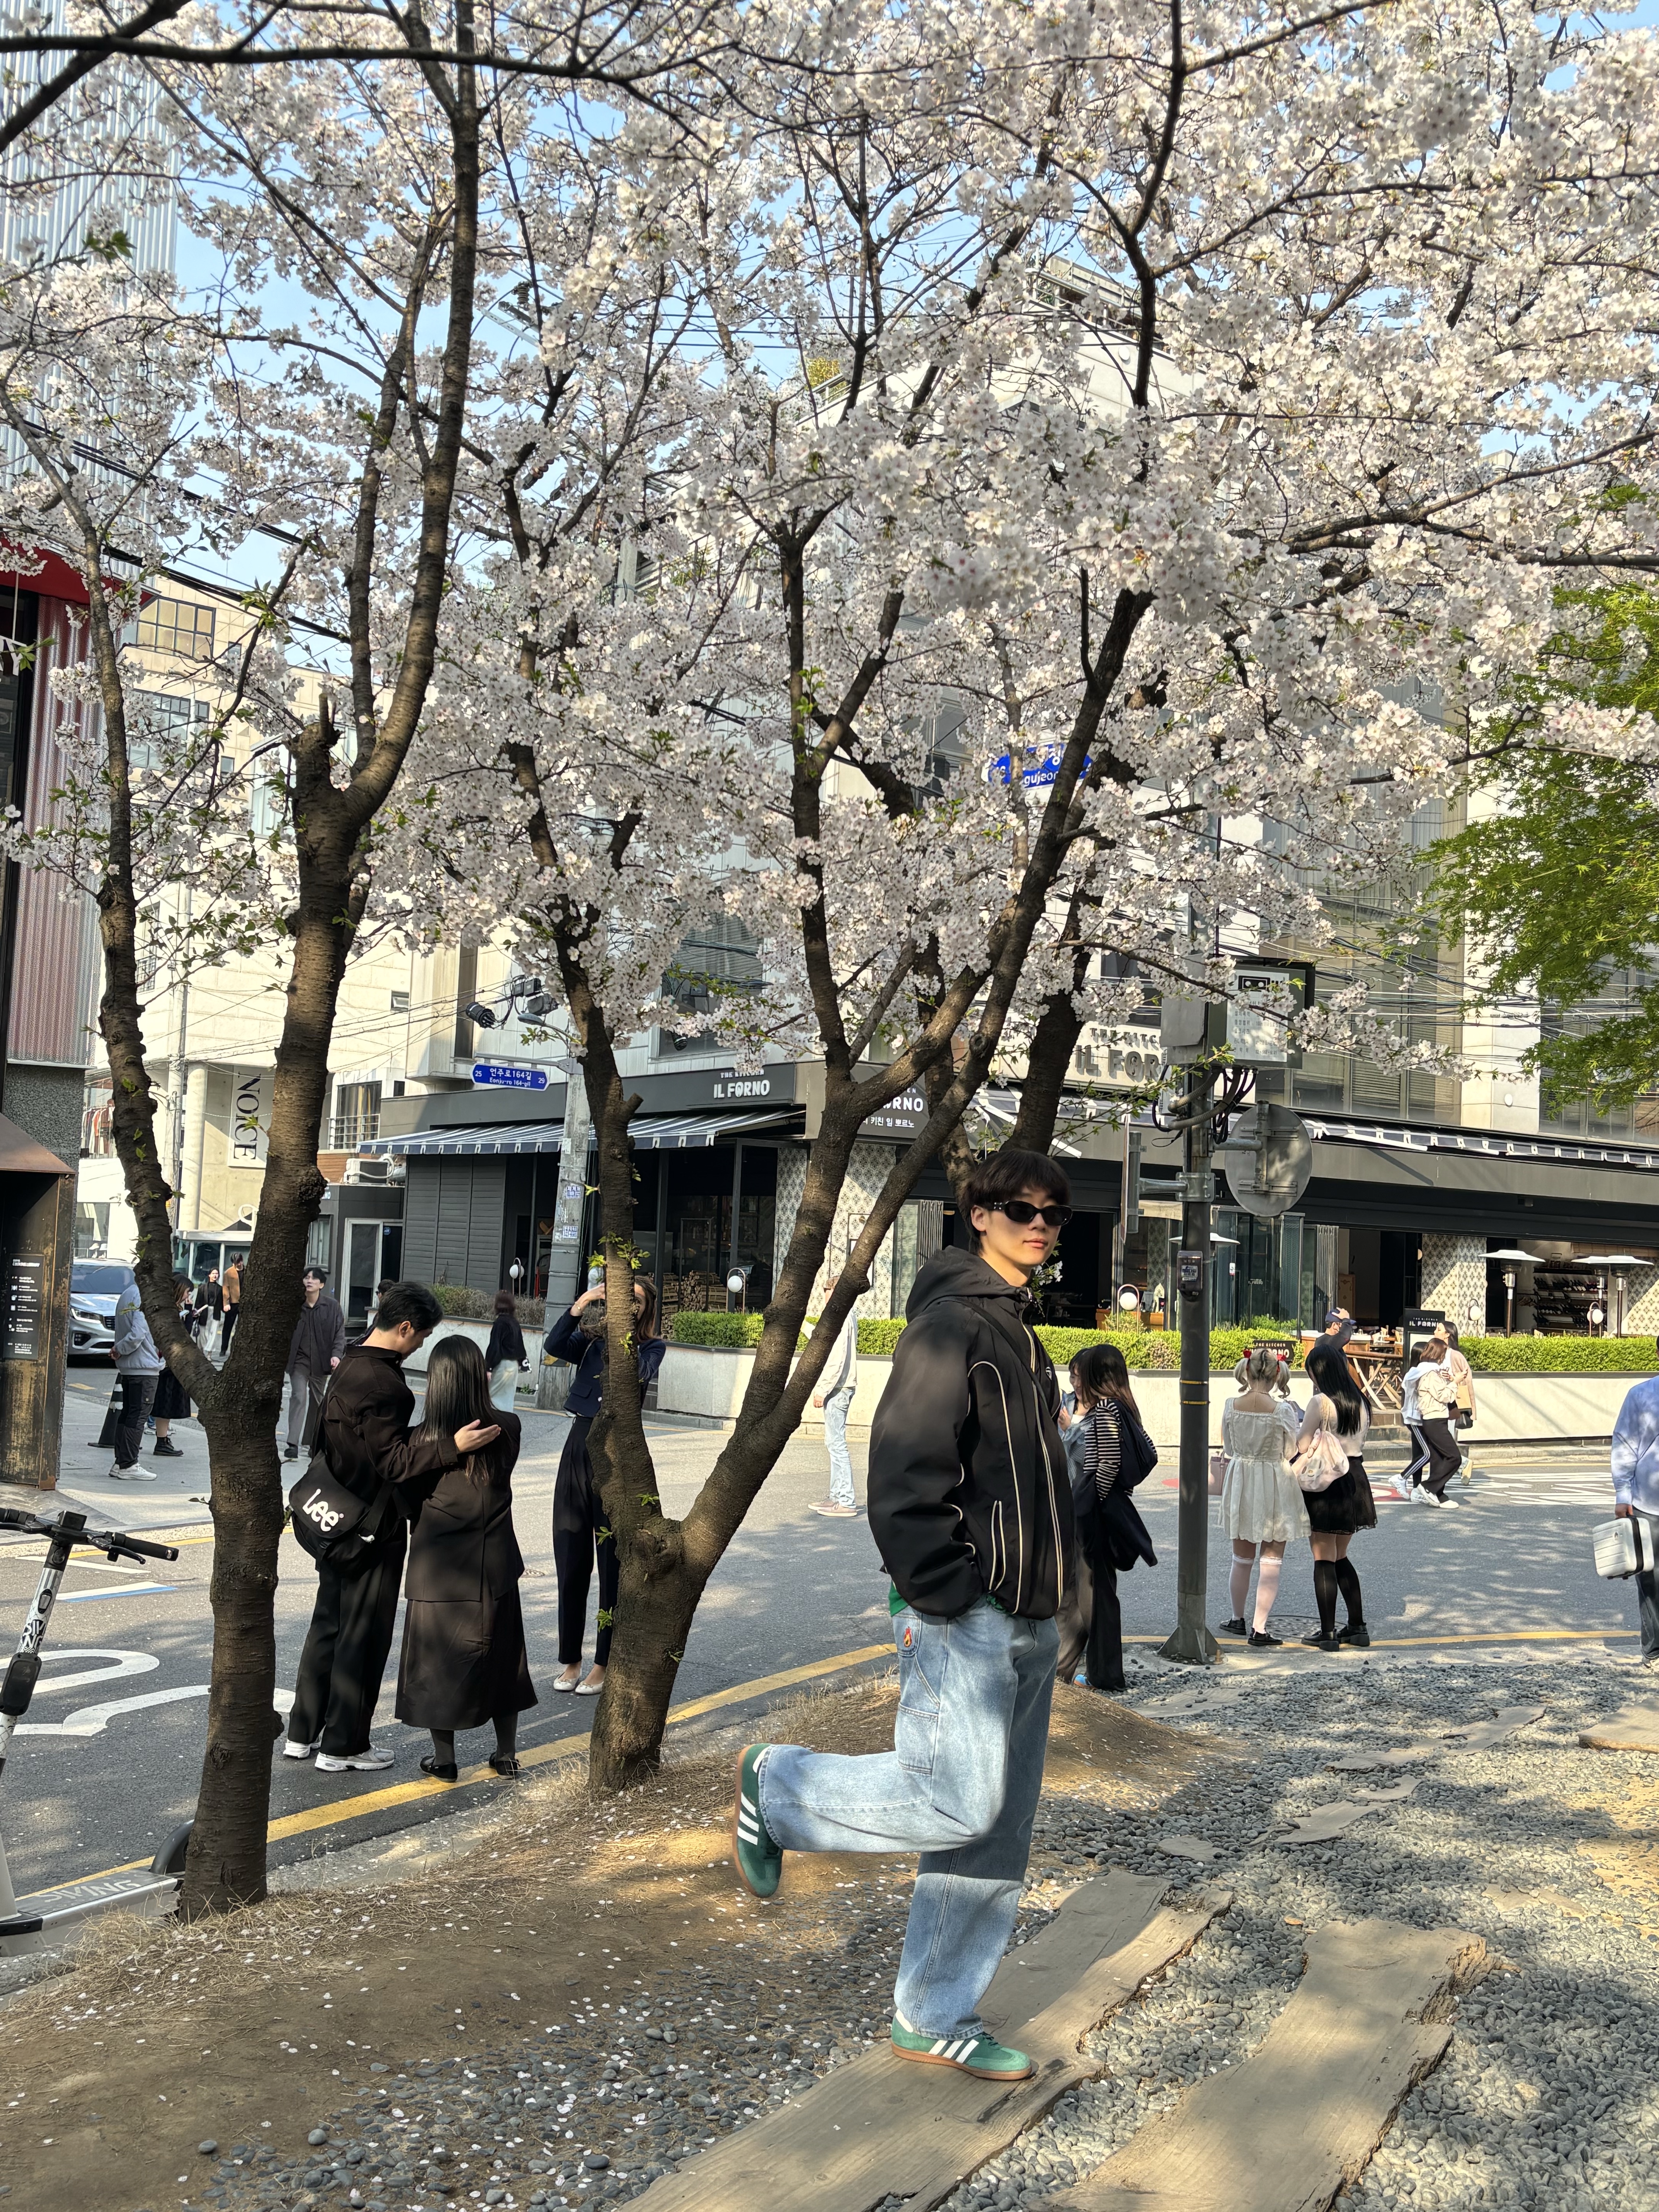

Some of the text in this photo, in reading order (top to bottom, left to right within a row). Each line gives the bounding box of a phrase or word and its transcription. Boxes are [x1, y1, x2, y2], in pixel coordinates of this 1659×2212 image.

[1075, 1045, 1099, 1070] IL
[1108, 1049, 1161, 1080] FOR
[489, 1077, 512, 1085] Eonju-ro
[490, 1068, 531, 1080] 언주로164길
[713, 1080, 770, 1098] IL FORNO
[883, 1096, 924, 1112] RNO
[233, 1070, 261, 1160] NOICE
[870, 1116, 884, 1126] 키친
[886, 1118, 893, 1127] 일
[1272, 1349, 1290, 1358] RNO
[302, 1488, 339, 1532] Lee
